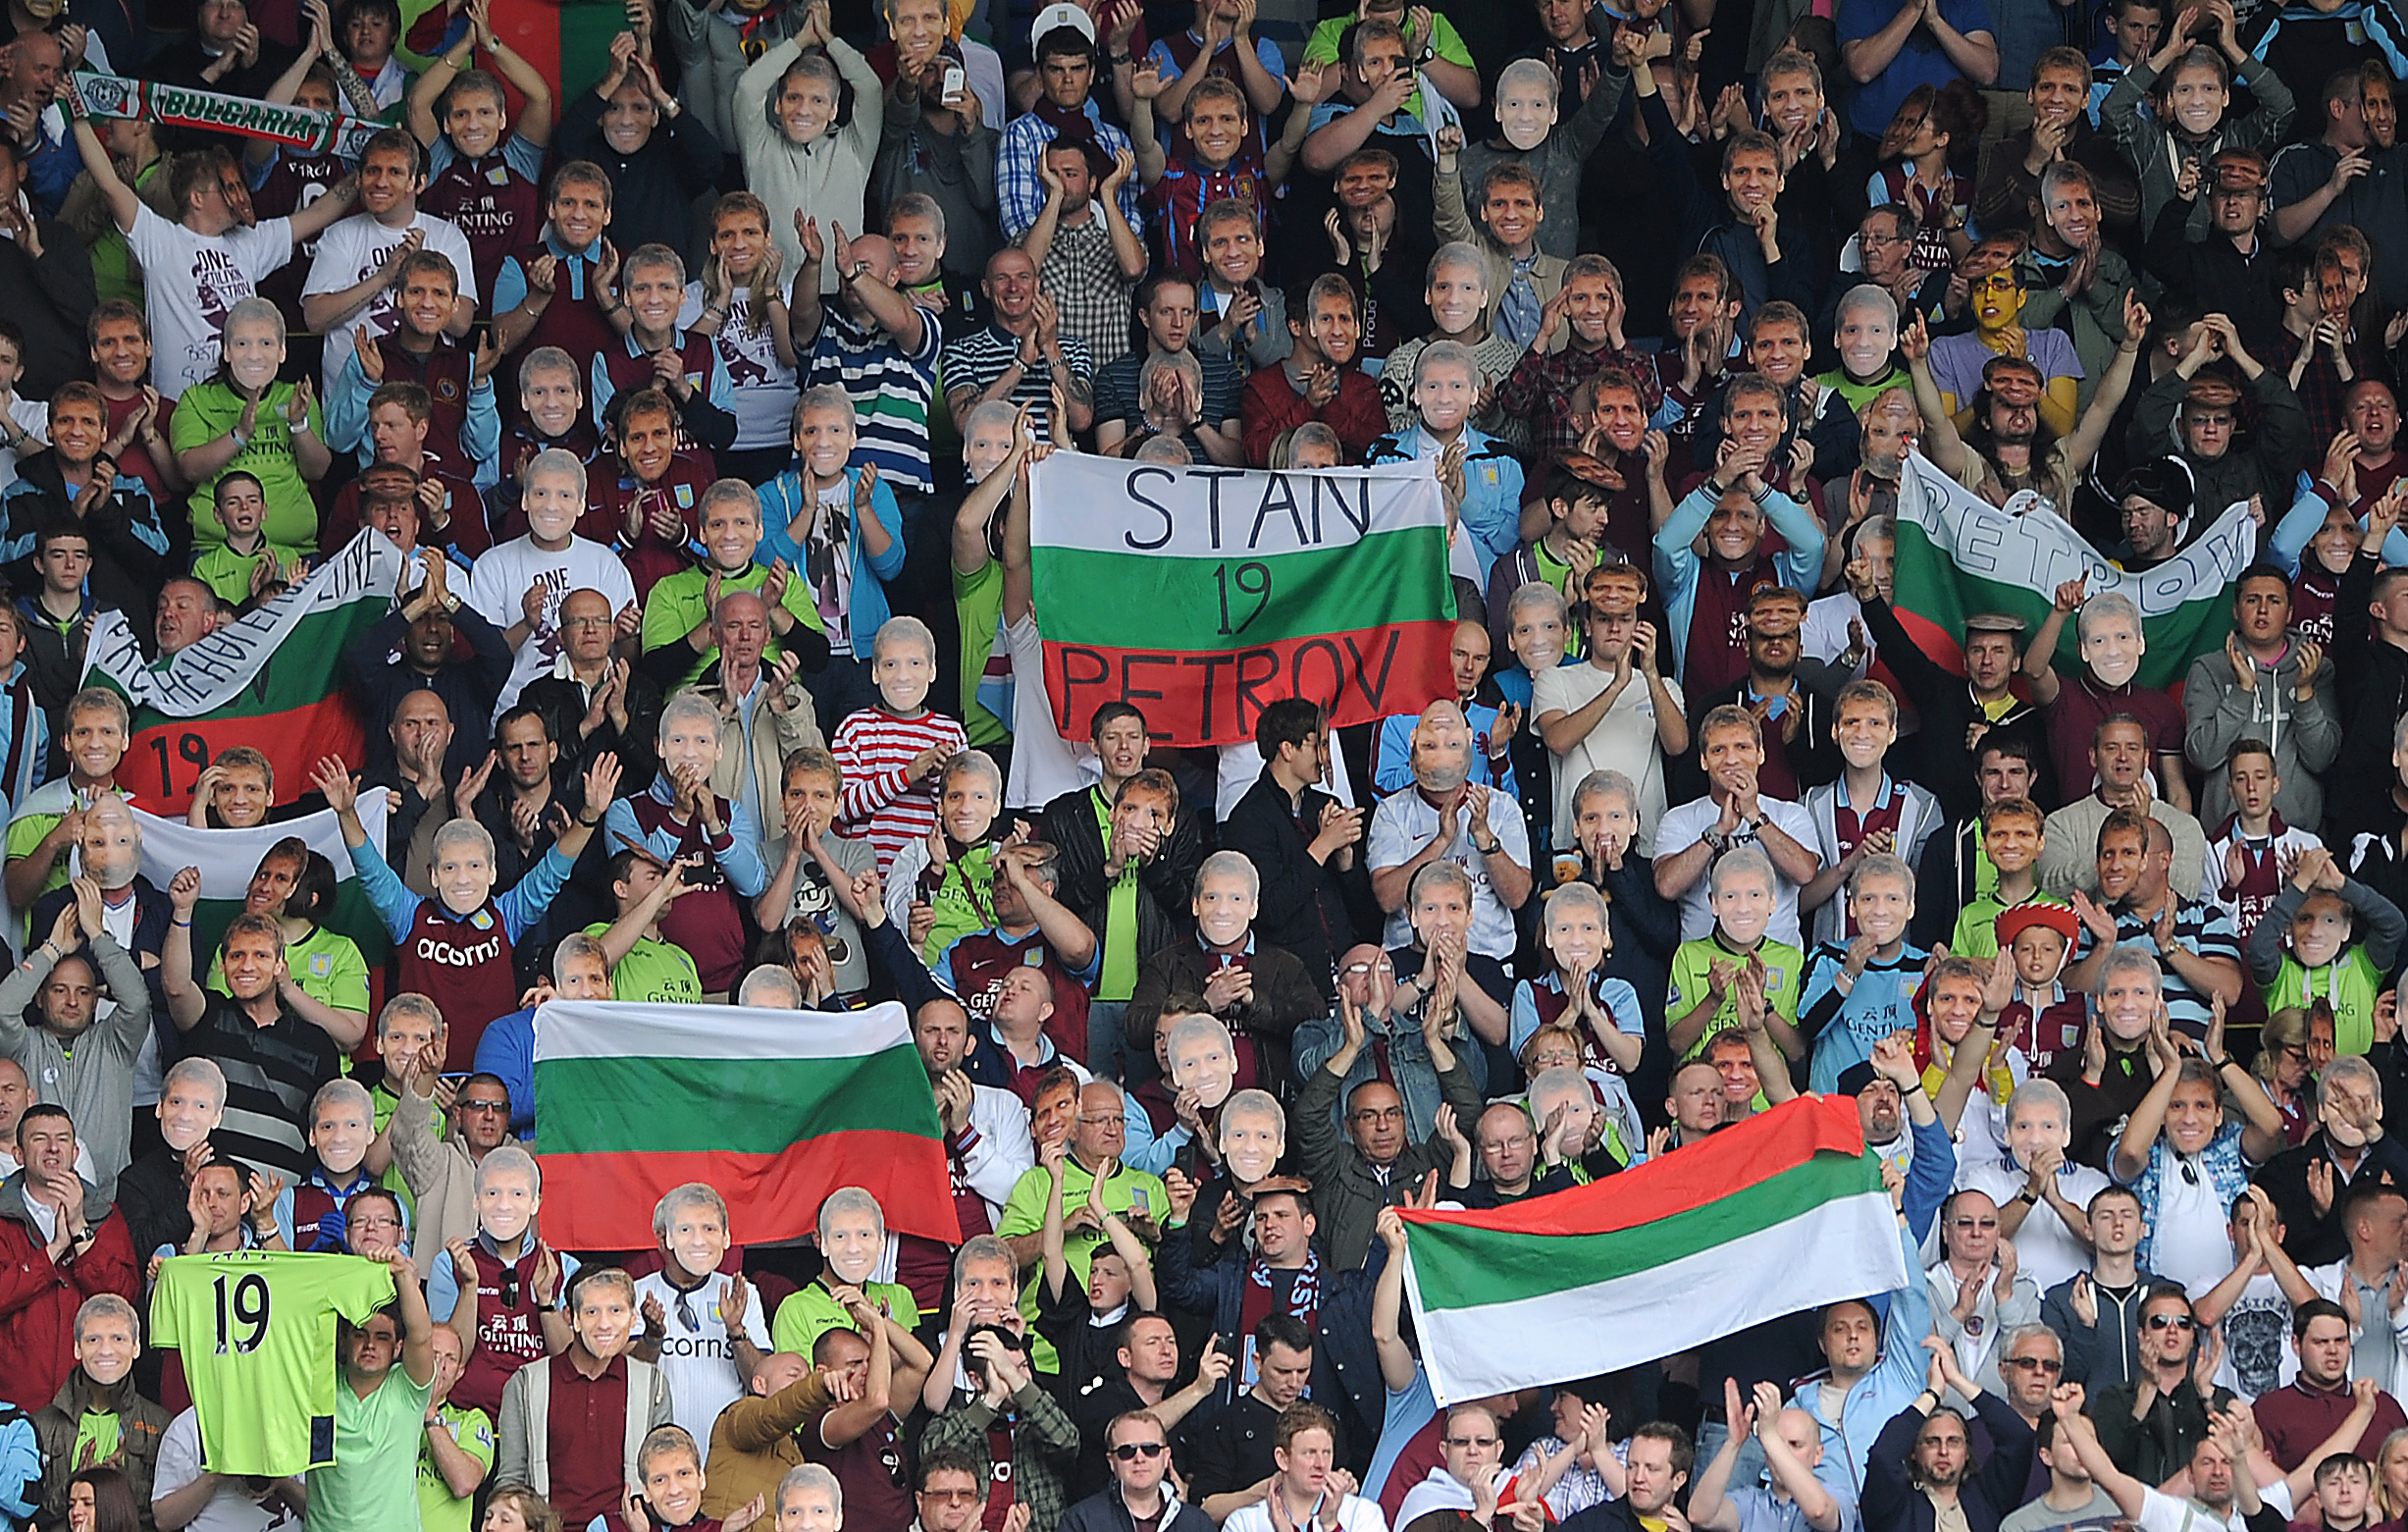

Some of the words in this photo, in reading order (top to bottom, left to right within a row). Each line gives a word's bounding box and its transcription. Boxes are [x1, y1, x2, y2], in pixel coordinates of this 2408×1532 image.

[163, 88, 313, 141] BULGARIA
[195, 248, 235, 272] ONE
[1124, 465, 1372, 550] STAN
[1914, 473, 2255, 614] PETROV
[533, 567, 571, 593] ONE
[1212, 561, 1273, 635] 19
[1061, 628, 1401, 741] PETROV
[149, 733, 210, 798] 19
[417, 935, 499, 968] acorns
[212, 1272, 272, 1357] 19
[478, 1324, 545, 1350] GENTING
[660, 1337, 735, 1360] corns
